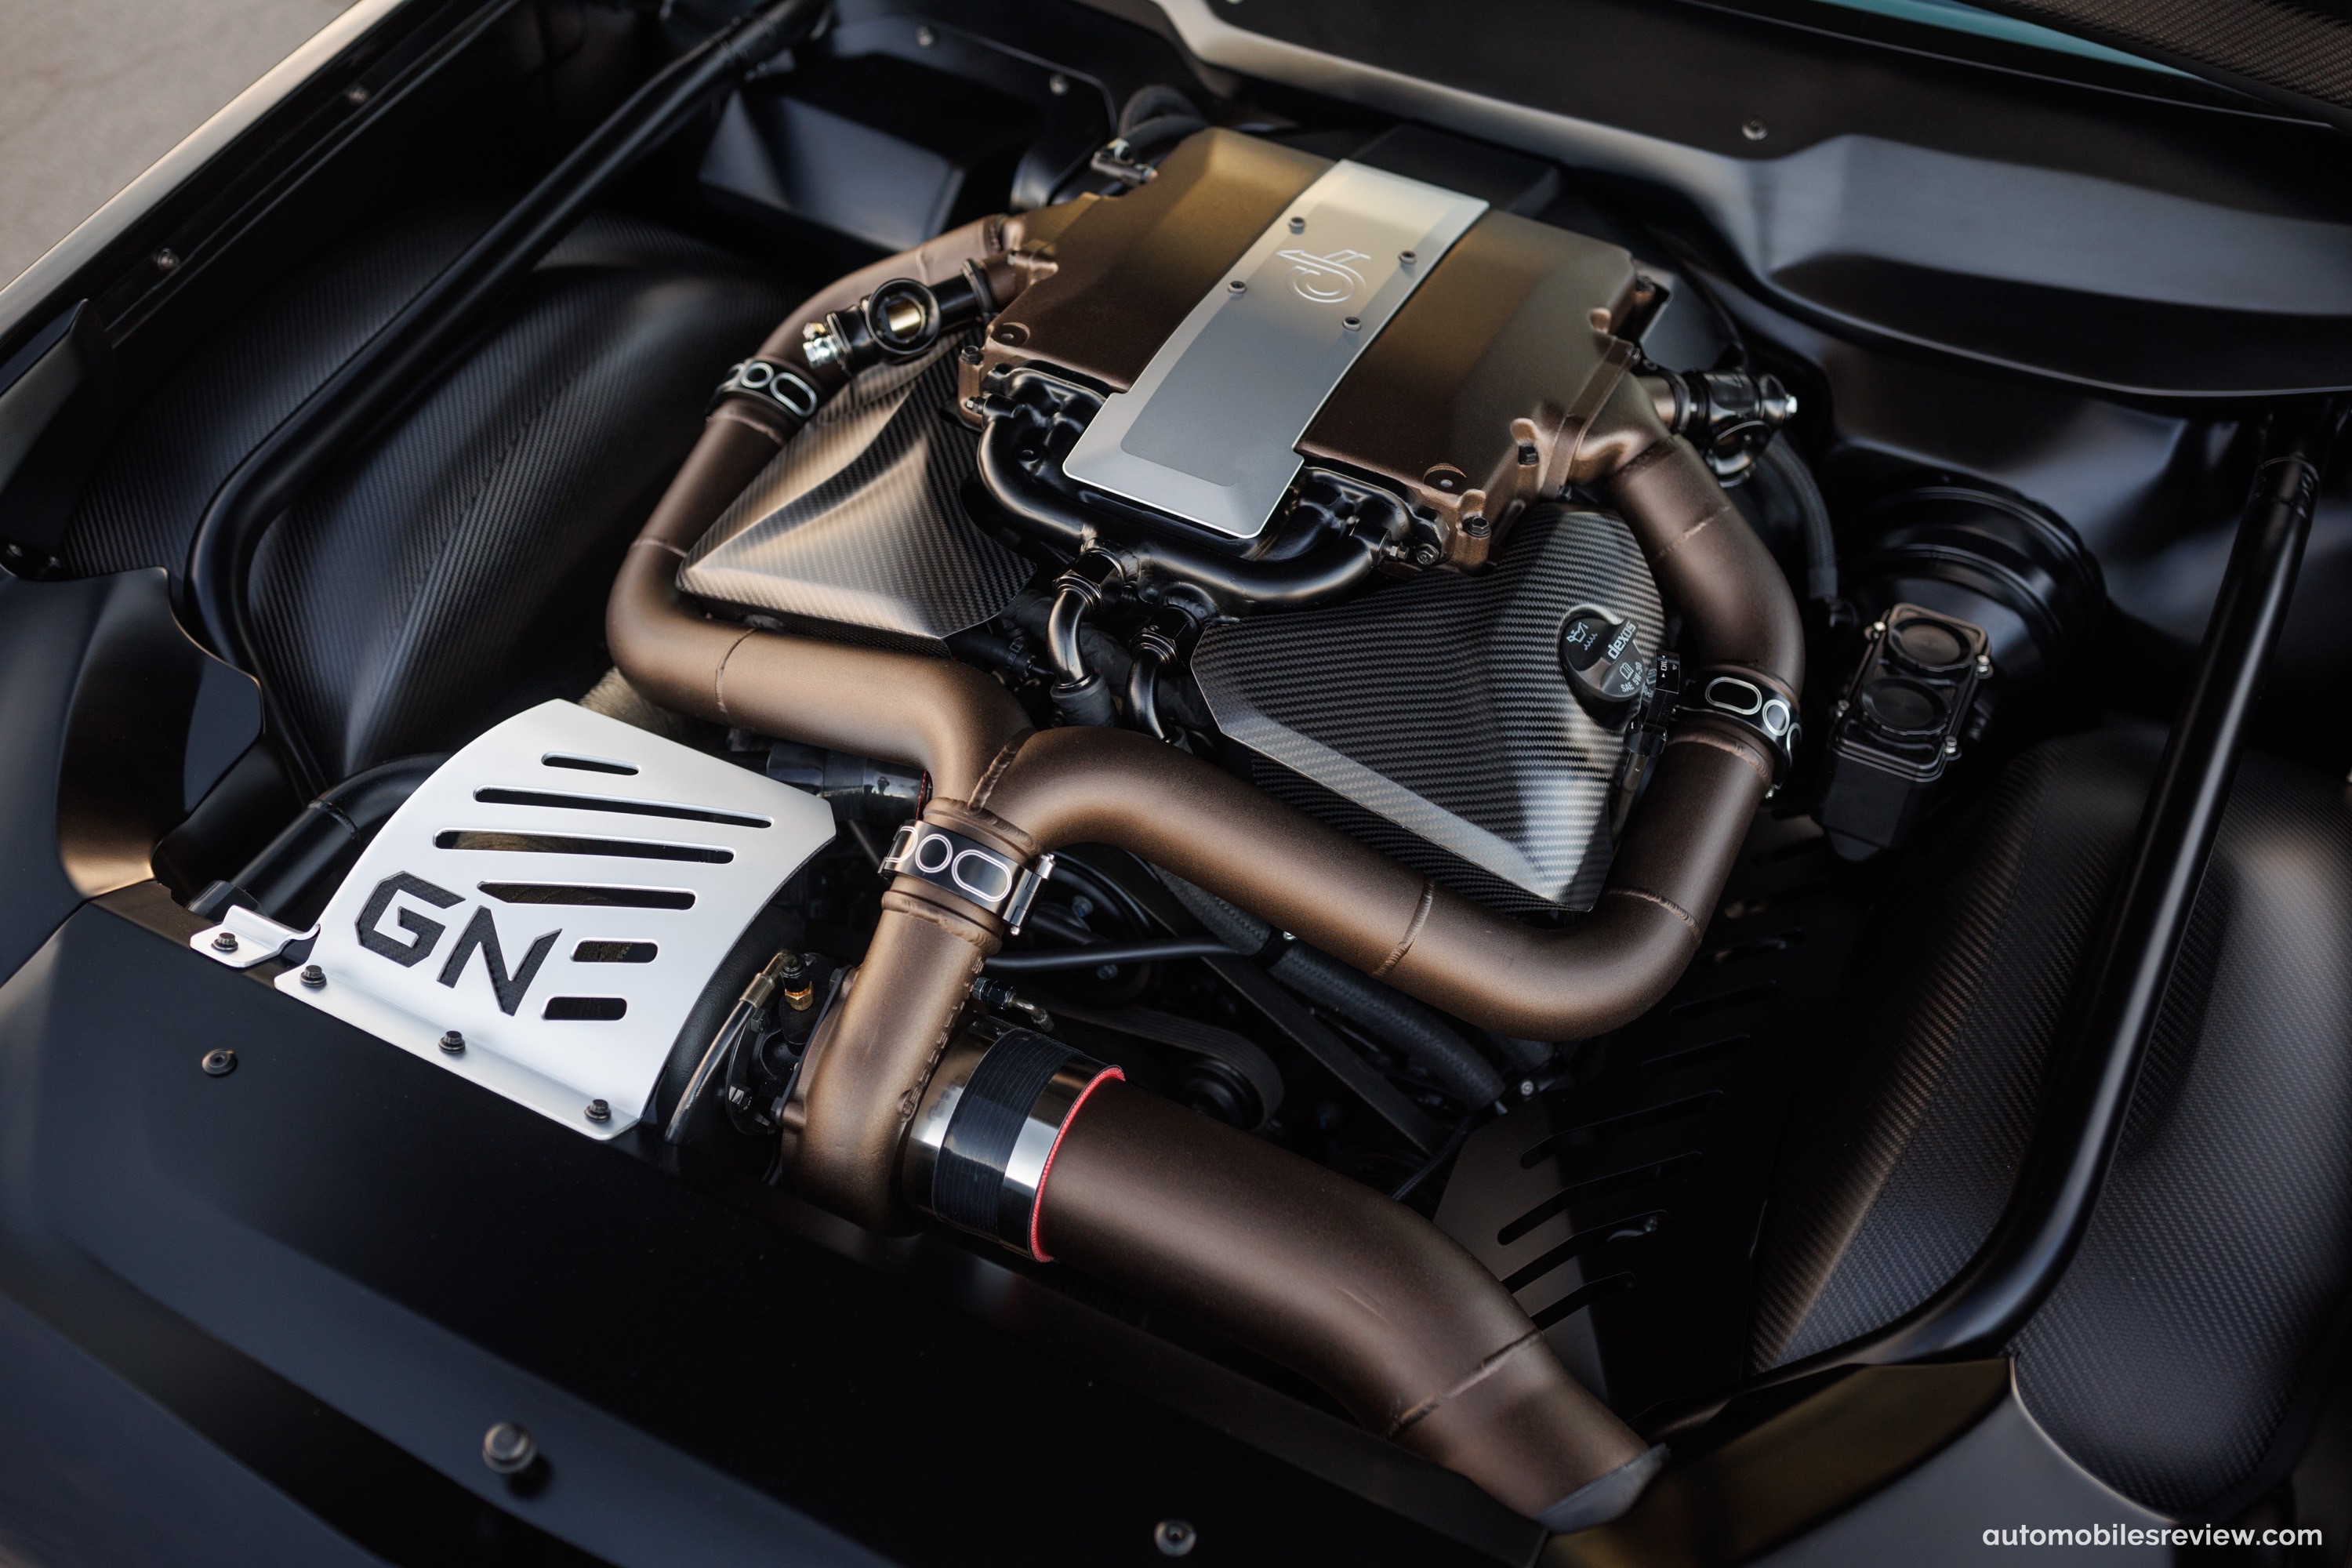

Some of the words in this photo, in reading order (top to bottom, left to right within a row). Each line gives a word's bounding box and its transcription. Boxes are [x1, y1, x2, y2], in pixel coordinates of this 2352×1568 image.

[1608, 621, 1636, 659] dexos
[1621, 681, 1635, 693] SAE
[1632, 662, 1643, 685] 5W-30
[354, 870, 562, 1016] GN
